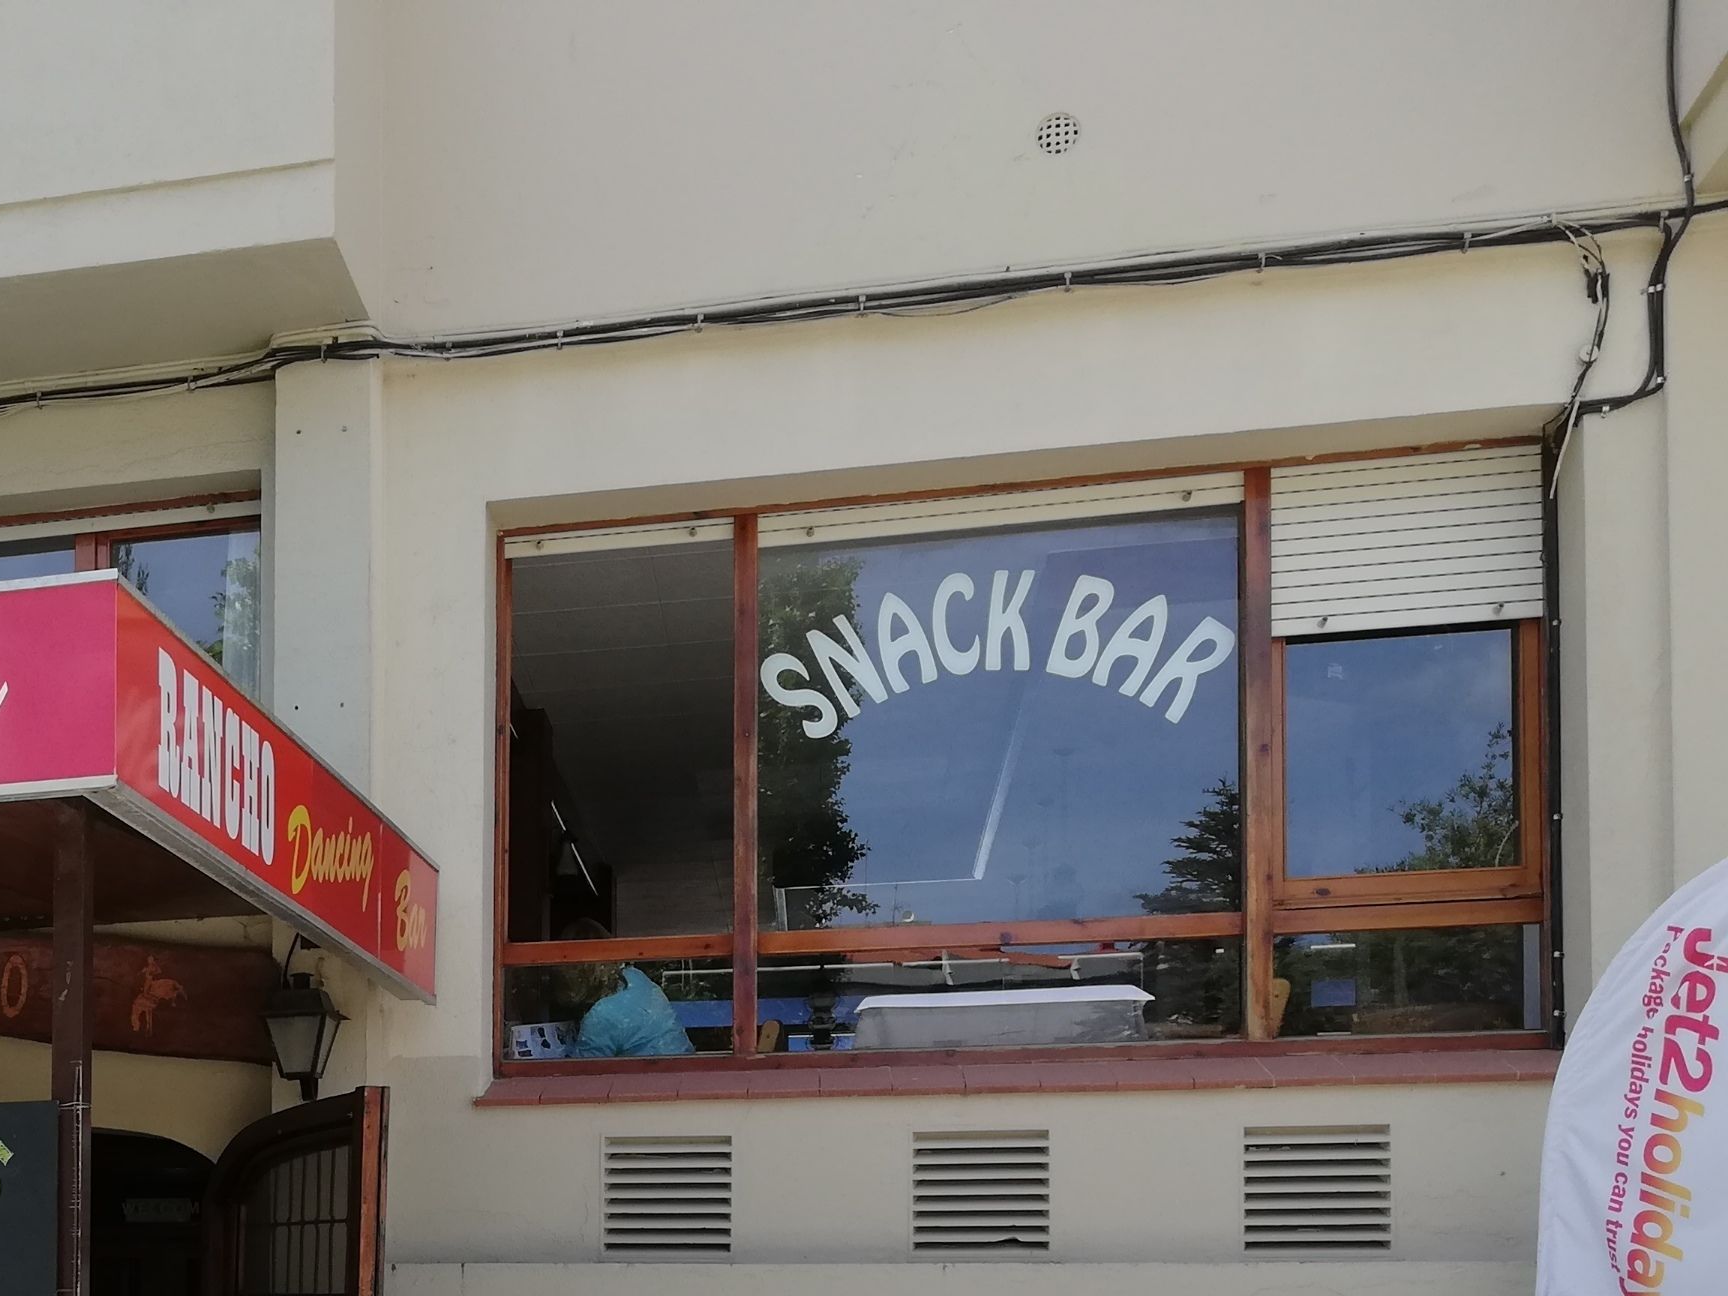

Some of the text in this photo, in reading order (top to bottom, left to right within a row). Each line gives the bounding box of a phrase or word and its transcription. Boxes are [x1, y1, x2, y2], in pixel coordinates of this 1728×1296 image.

[157, 646, 428, 951] RANCHO Dancing Bar
[759, 569, 1237, 740] SNACK BAR
[1606, 925, 1685, 1273] Package holidays you can trust
